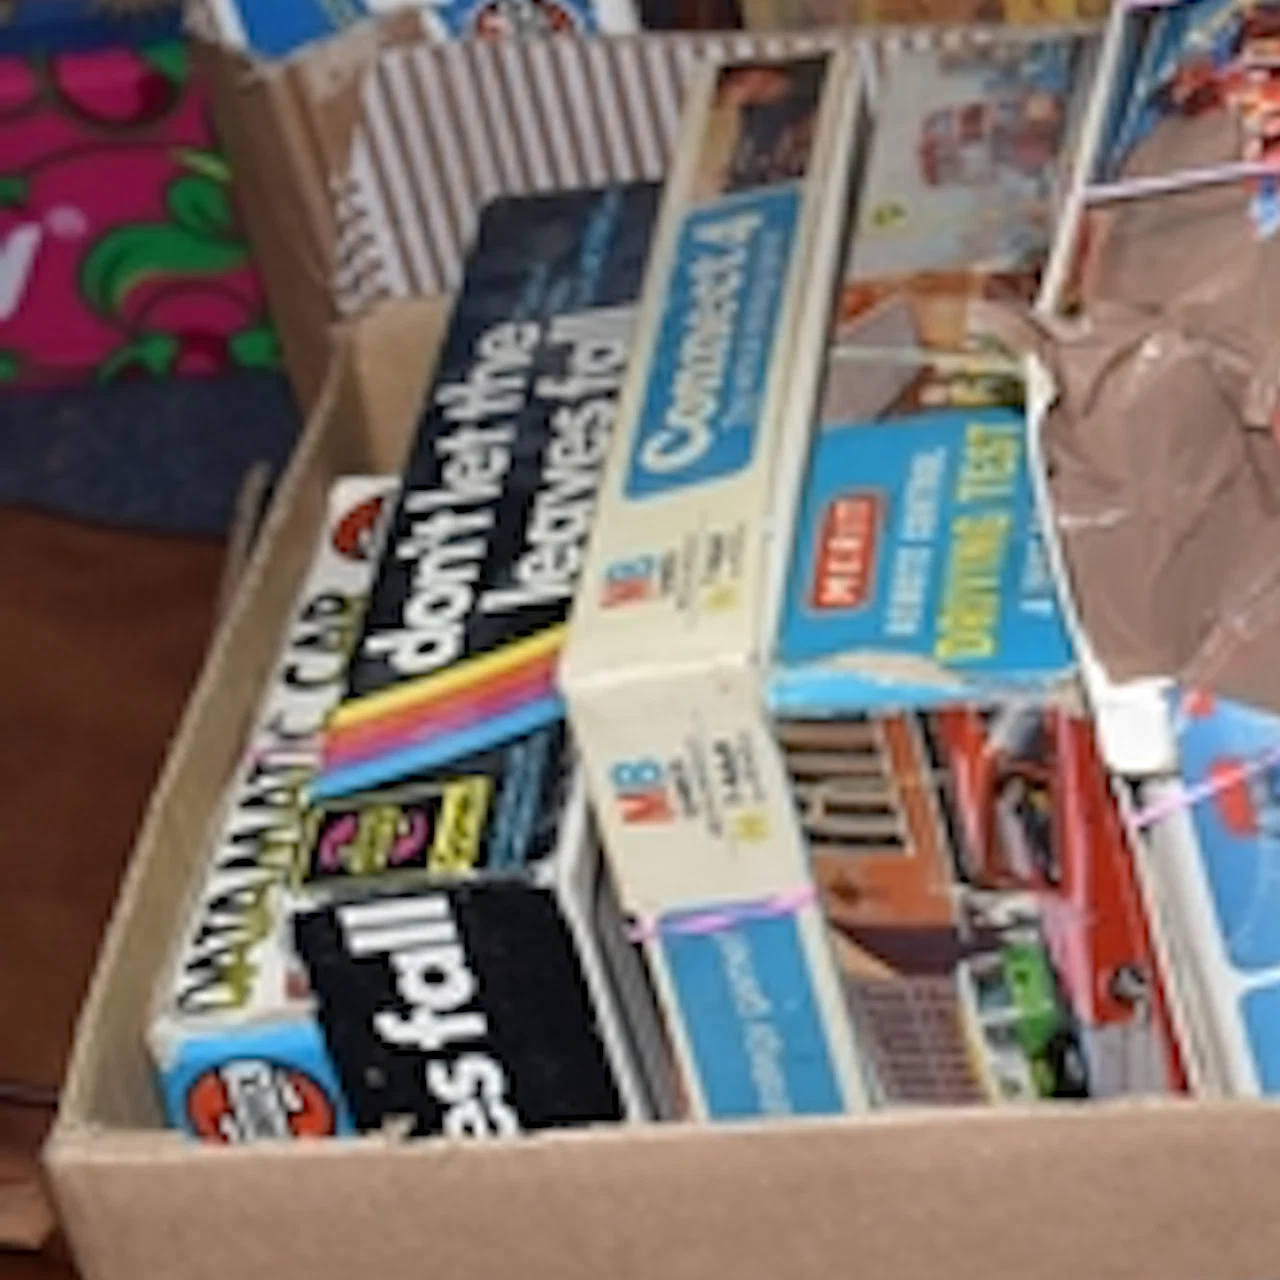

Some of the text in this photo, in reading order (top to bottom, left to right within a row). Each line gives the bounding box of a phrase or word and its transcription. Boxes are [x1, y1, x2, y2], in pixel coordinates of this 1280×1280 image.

[434, 320, 541, 422] the
[405, 420, 518, 523] let
[365, 522, 494, 673] don't
[936, 423, 1024, 658] DRIVING TEST
[611, 760, 673, 823] MB
[336, 895, 489, 1053] fall
